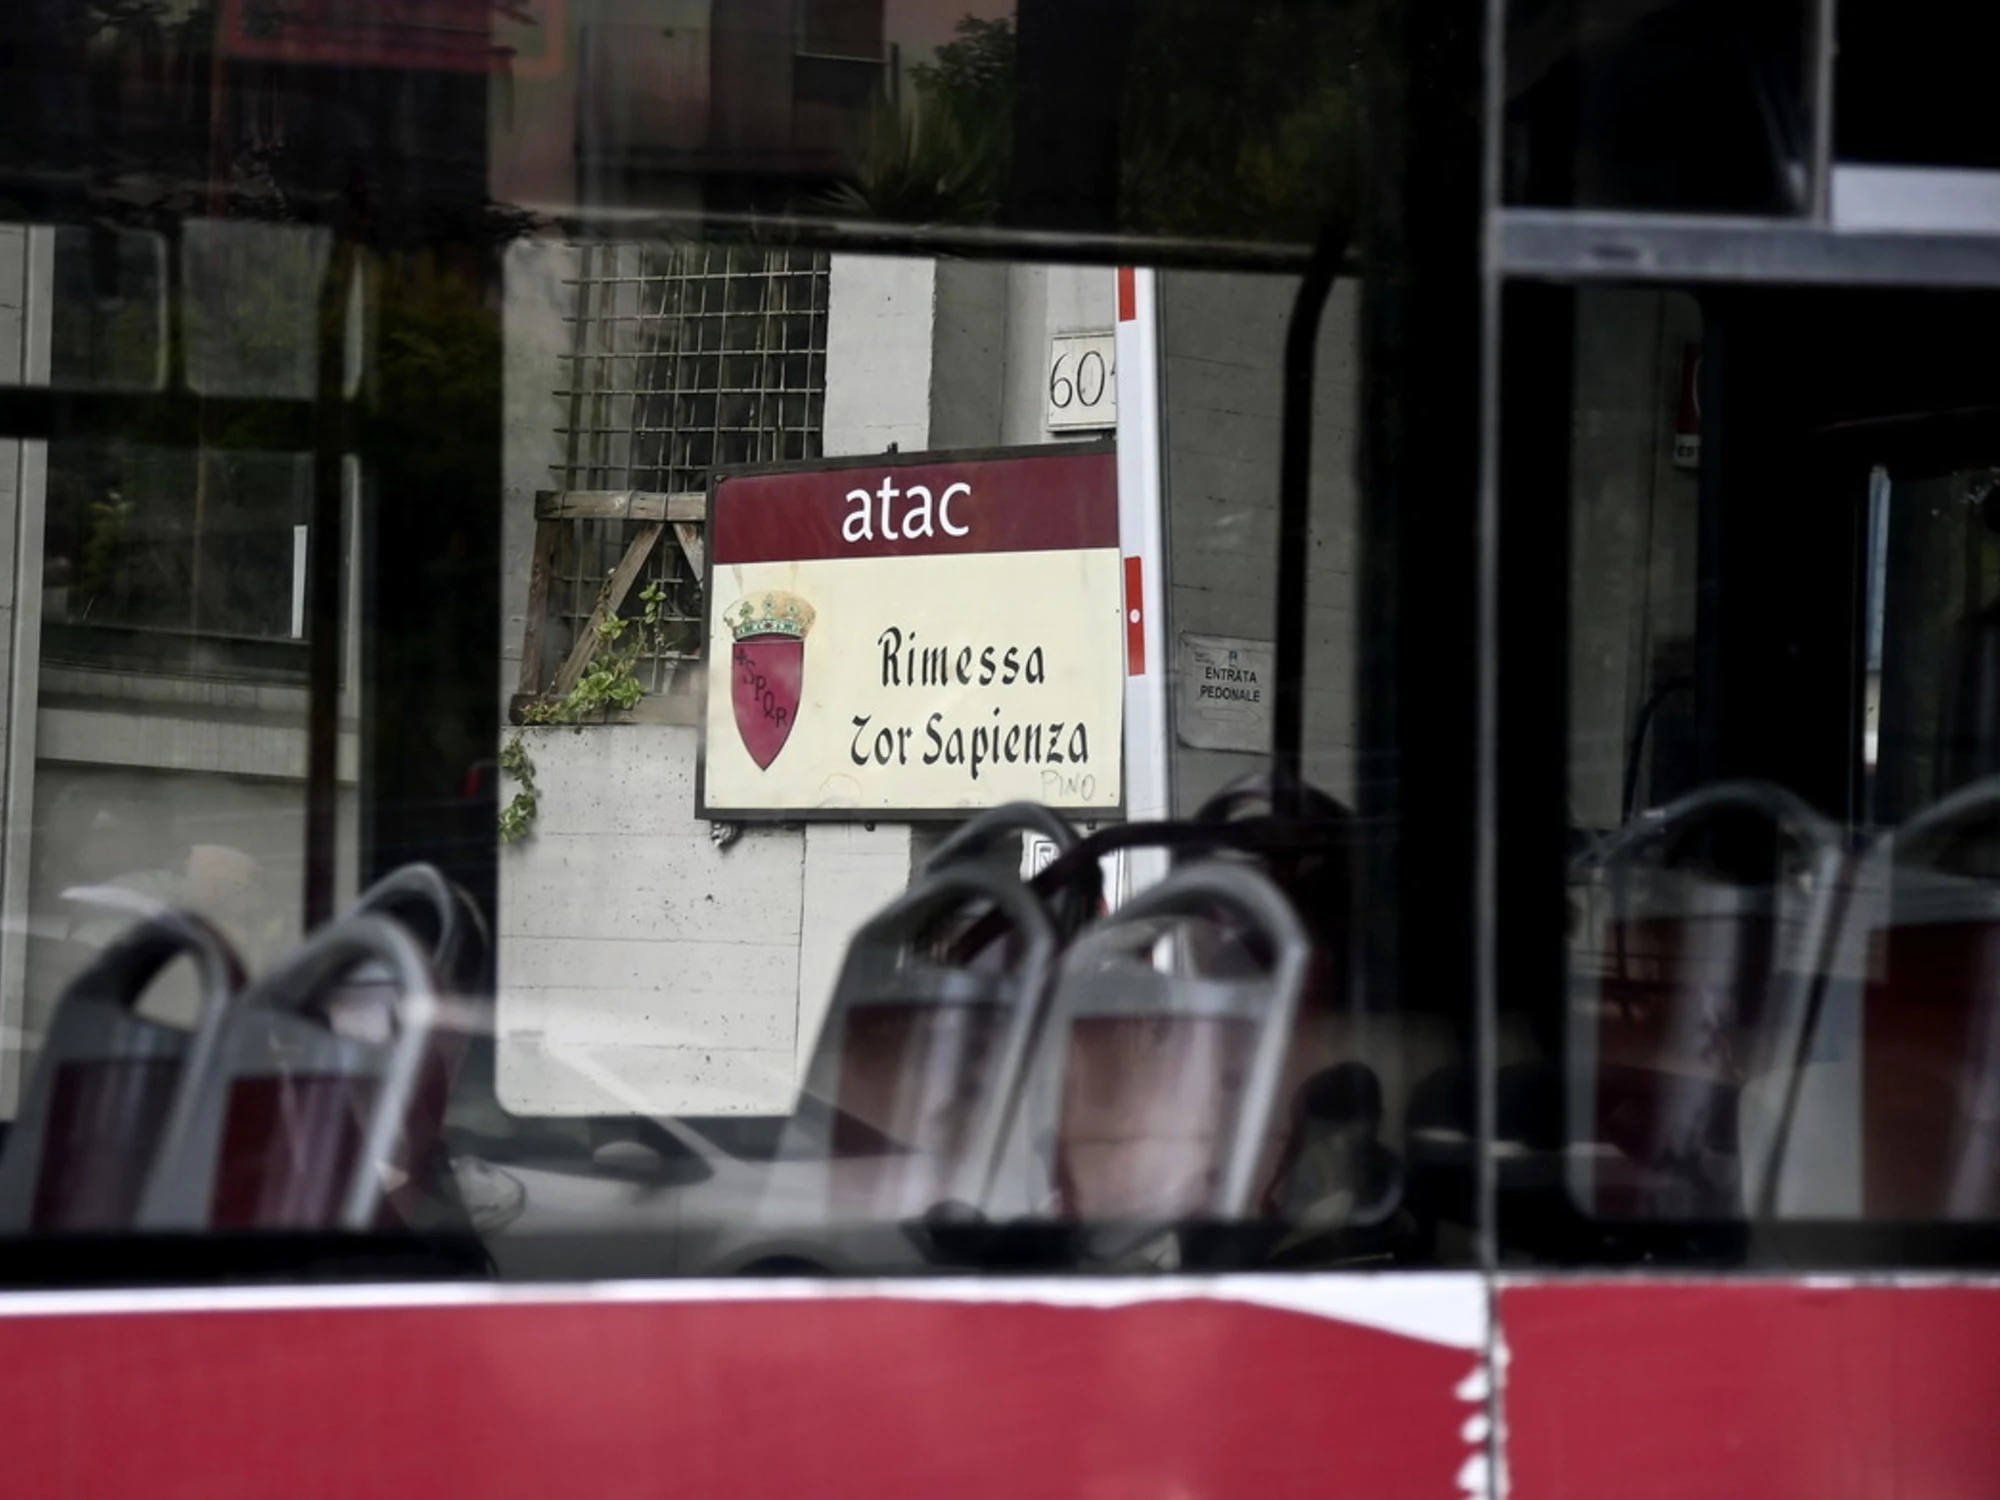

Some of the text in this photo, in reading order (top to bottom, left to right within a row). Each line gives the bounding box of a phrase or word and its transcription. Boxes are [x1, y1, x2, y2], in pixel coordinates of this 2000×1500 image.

[1050, 350, 1117, 408] 60
[842, 476, 971, 541] atac
[877, 627, 1046, 687] Rimessa
[1205, 666, 1257, 684] ENTRATA
[1200, 685, 1260, 703] PEDONALE
[850, 707, 1089, 779] Tor Sapienza
